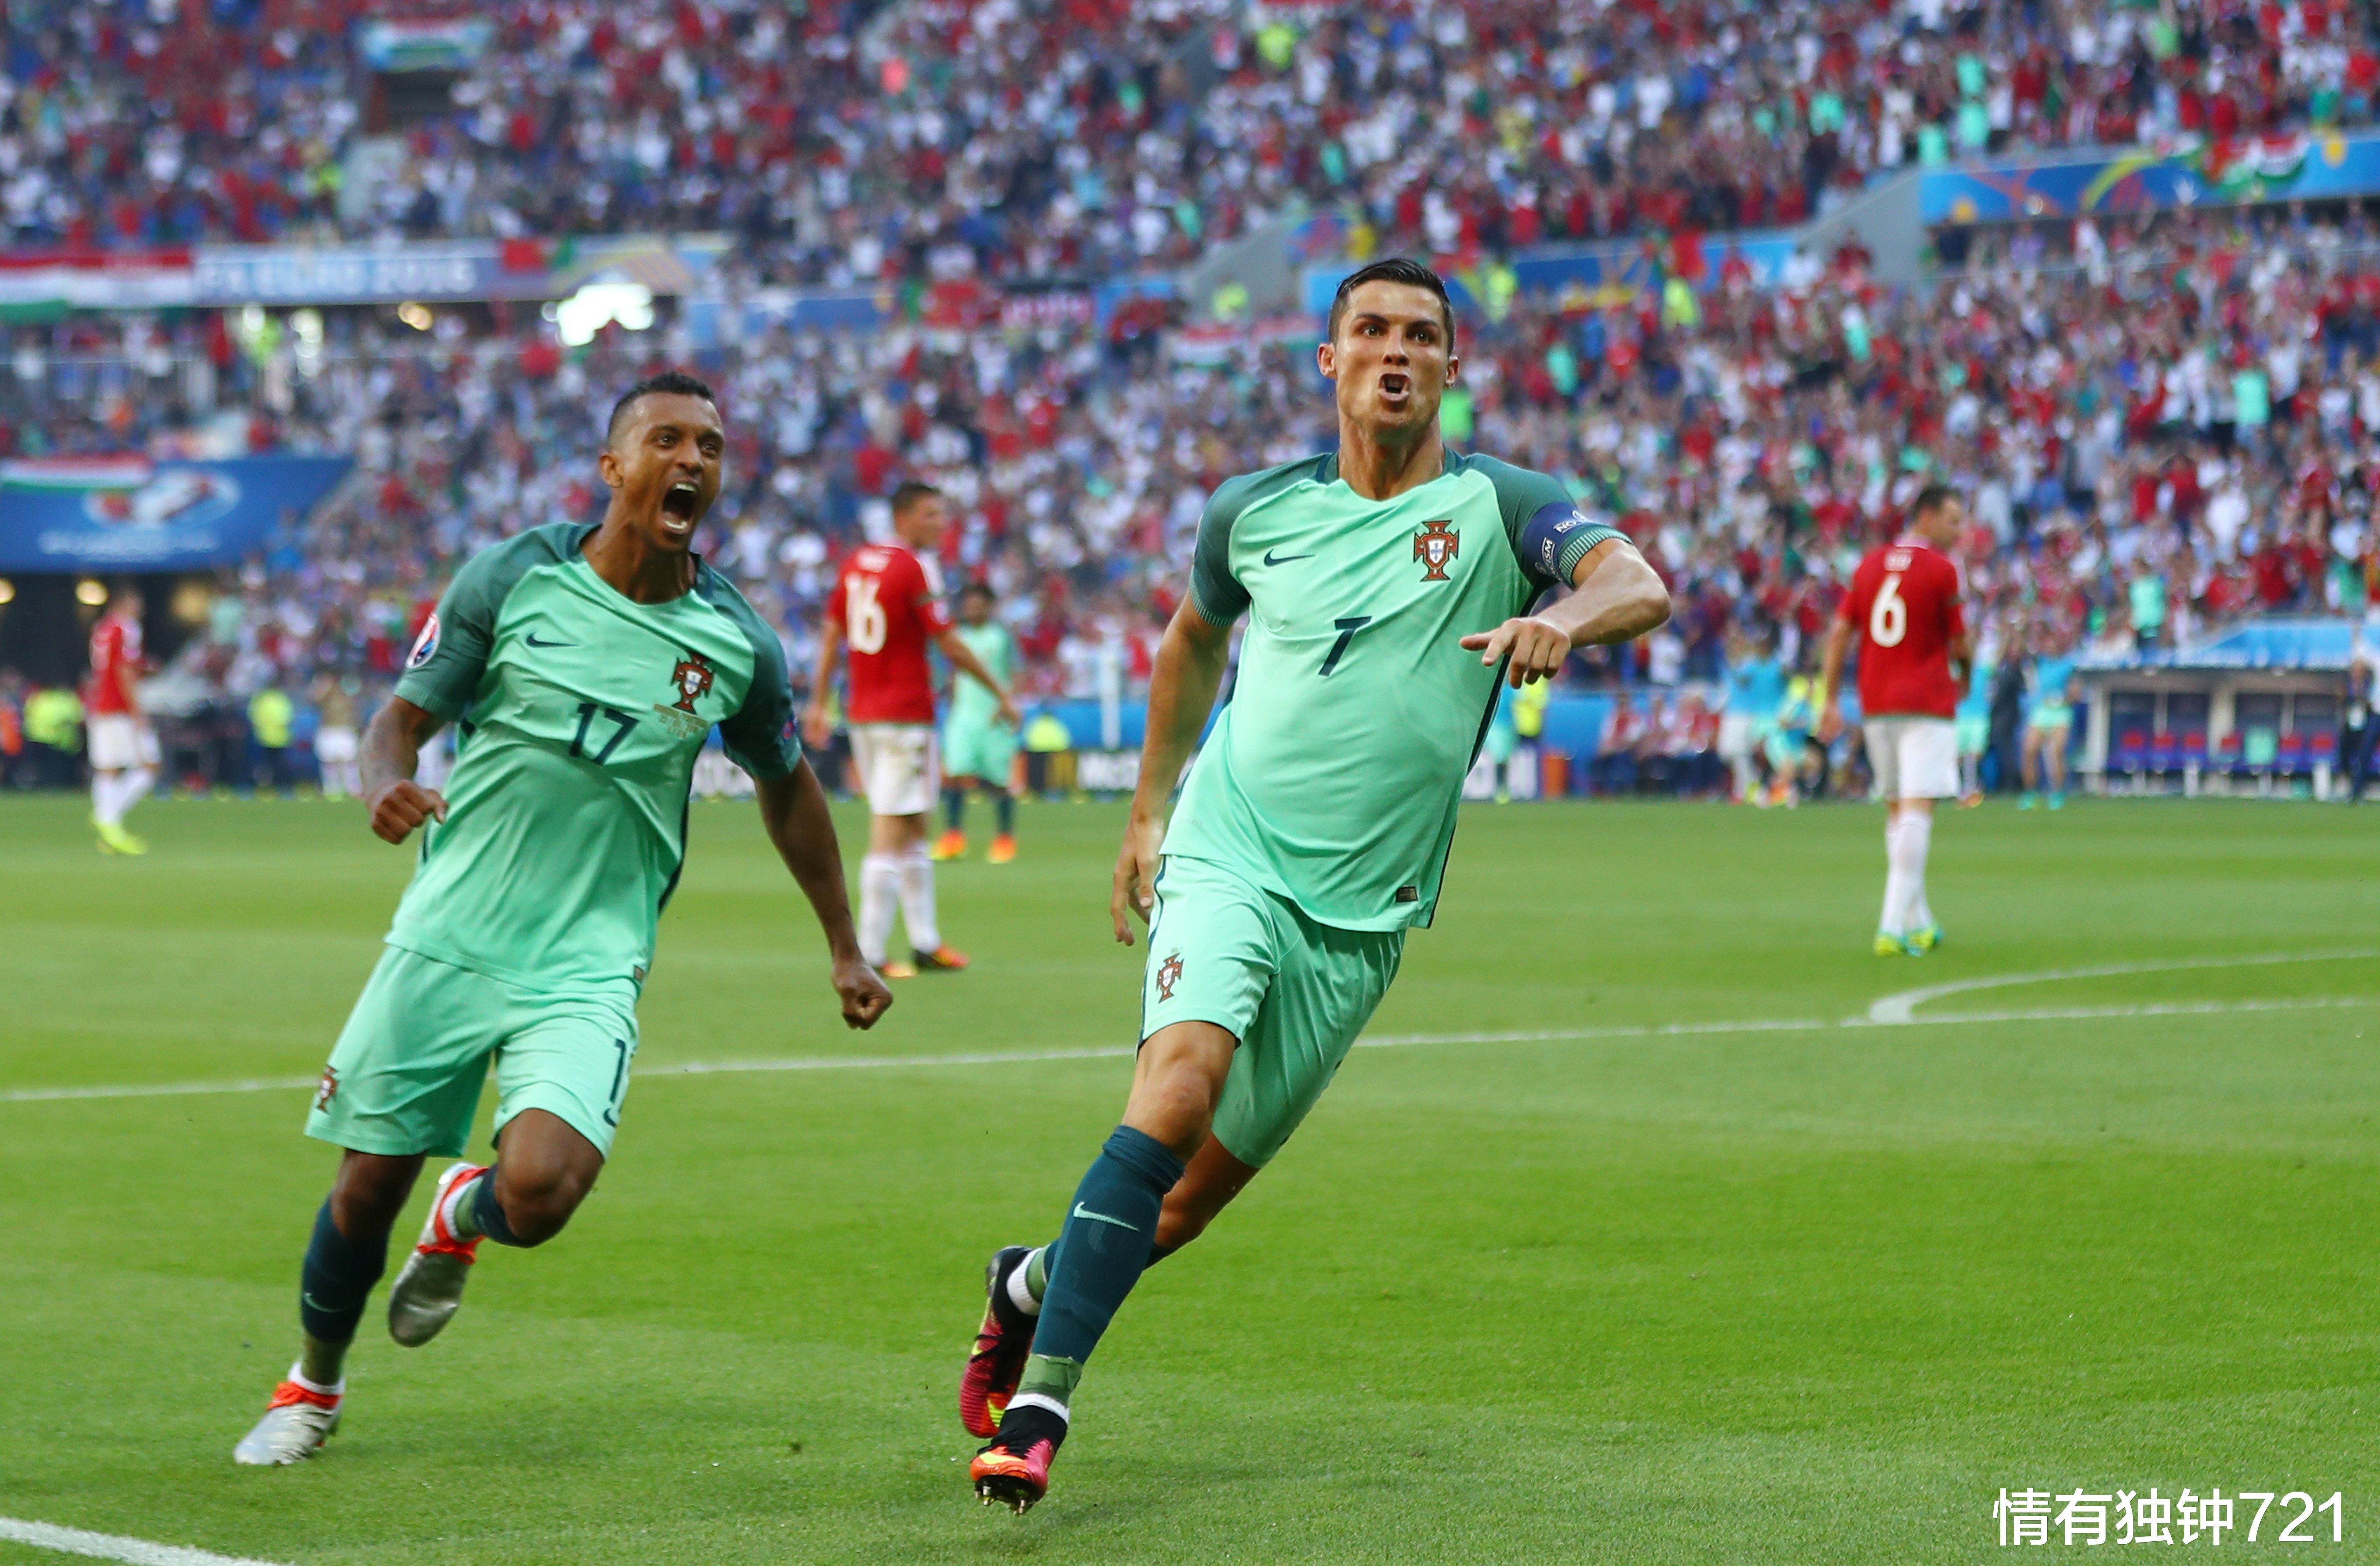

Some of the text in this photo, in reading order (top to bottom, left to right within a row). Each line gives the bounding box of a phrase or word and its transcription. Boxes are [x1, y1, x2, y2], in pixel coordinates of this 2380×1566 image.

[845, 571, 887, 655] 16
[1870, 572, 1908, 648] 6
[1318, 616, 1373, 677] 7
[568, 703, 640, 766] 17
